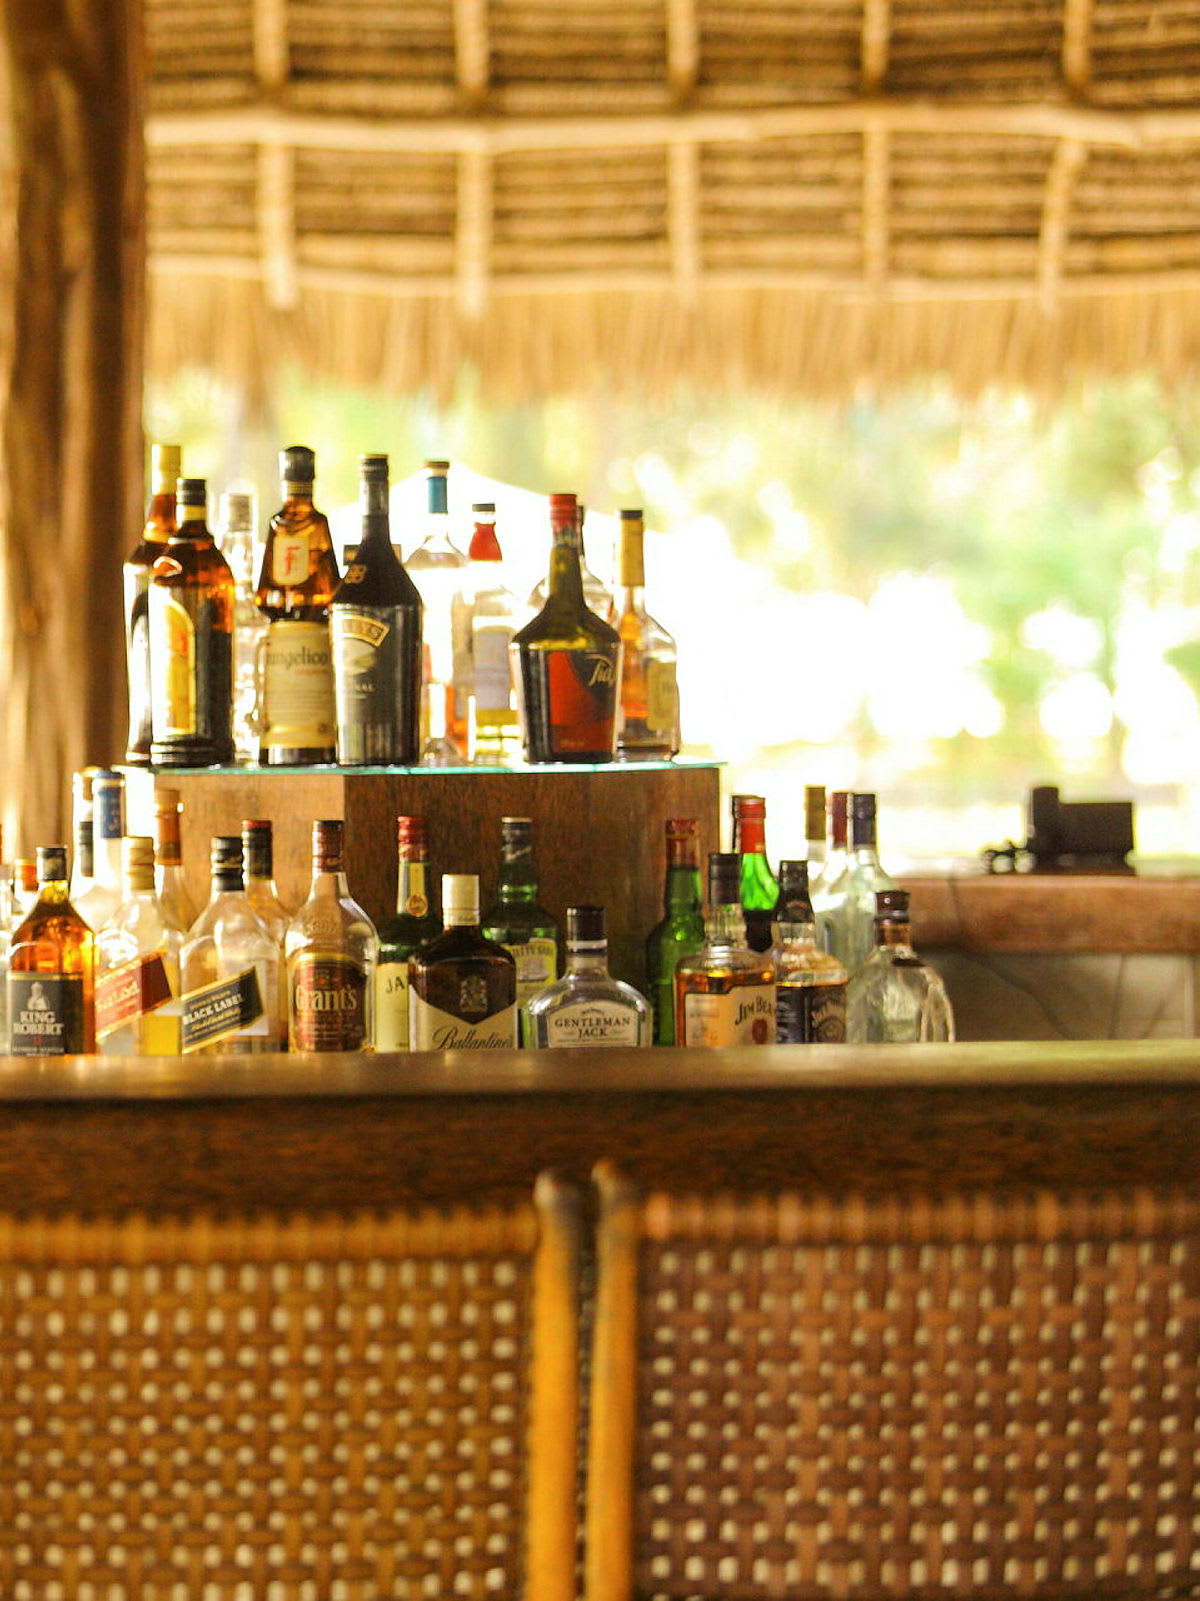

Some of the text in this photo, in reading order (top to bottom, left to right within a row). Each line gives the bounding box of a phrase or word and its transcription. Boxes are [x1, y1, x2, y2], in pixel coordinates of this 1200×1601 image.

[756, 995, 774, 1016] BEA
[19, 1011, 55, 1023] KING
[554, 1016, 630, 1028] GENTLEMAN
[13, 1022, 64, 1035] ROBERT
[578, 1027, 608, 1039] JACK
[430, 1024, 515, 1050] Ballantine's
